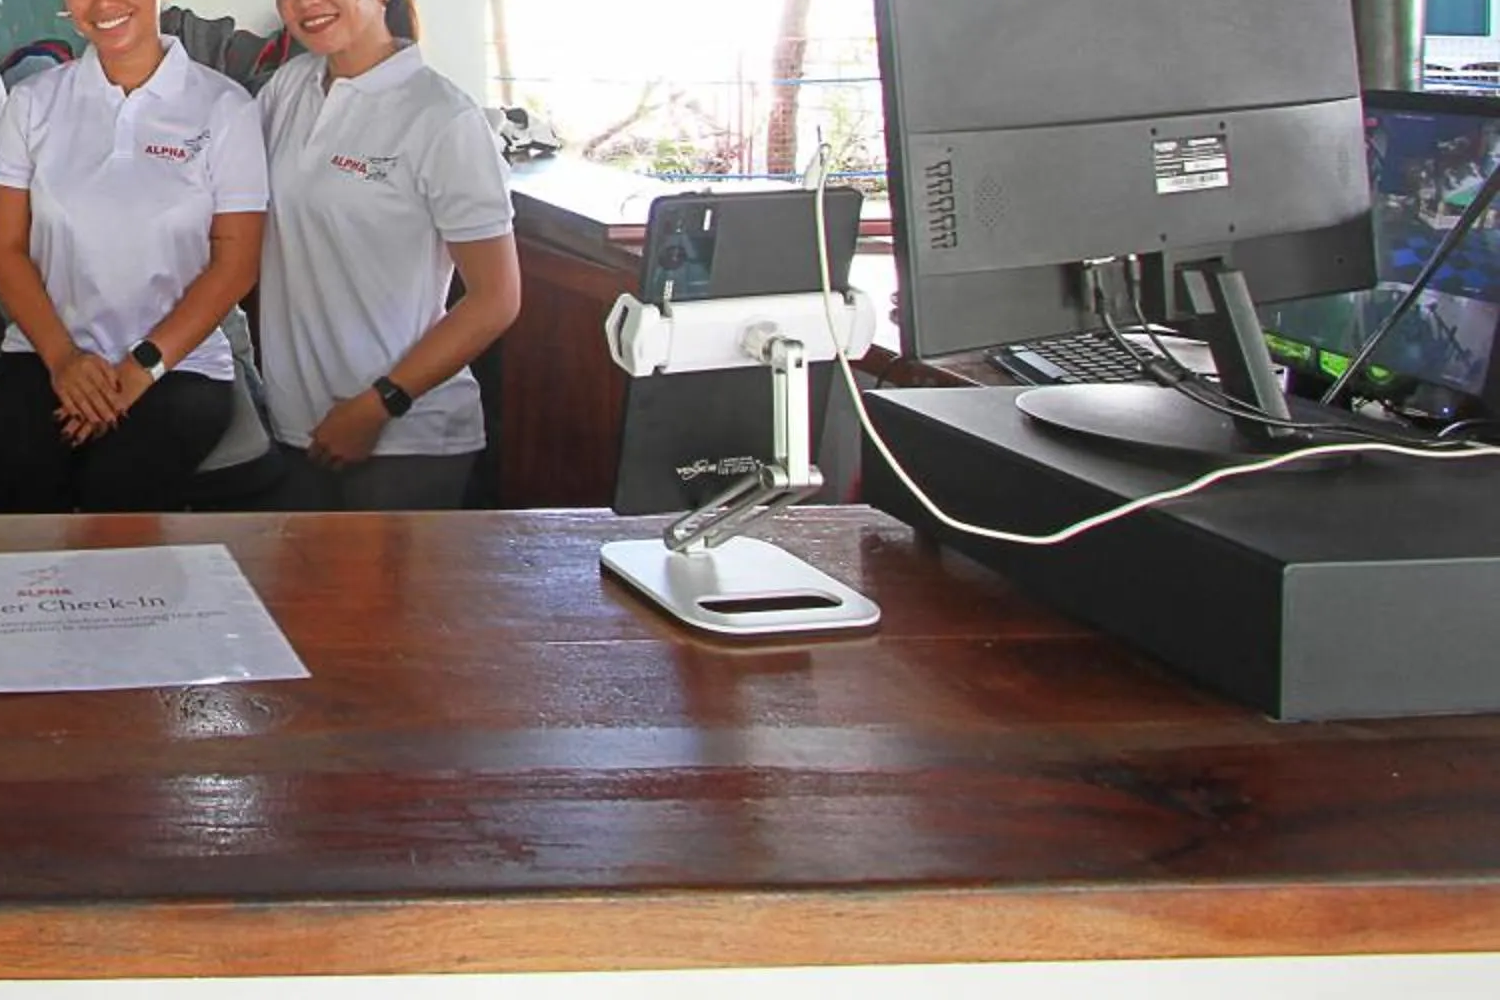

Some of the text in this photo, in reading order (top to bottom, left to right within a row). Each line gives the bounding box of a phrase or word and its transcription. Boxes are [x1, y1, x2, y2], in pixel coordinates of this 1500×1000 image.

[145, 145, 186, 158] ALPHA
[330, 155, 367, 174] ALPHA
[17, 588, 73, 598] ALPHA
[38, 596, 166, 614] Check-In
